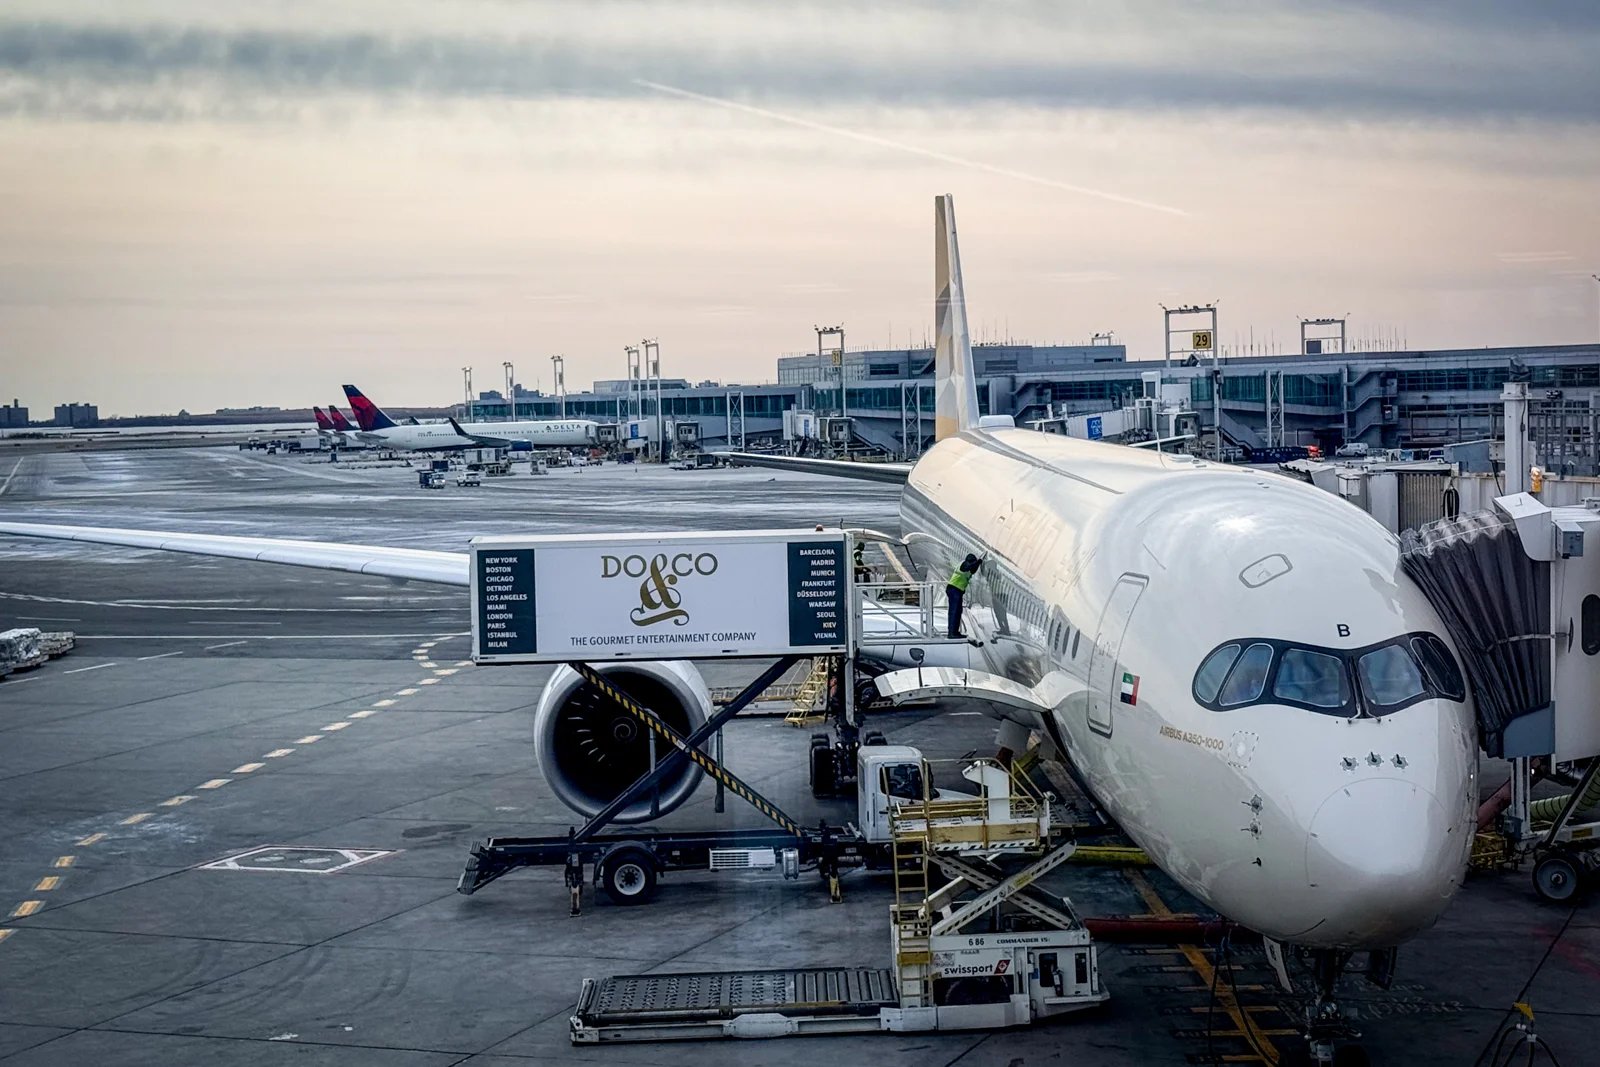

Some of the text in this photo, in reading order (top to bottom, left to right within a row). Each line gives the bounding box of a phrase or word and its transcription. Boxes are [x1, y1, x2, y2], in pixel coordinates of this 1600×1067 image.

[1195, 334, 1208, 347] 29
[601, 553, 718, 627] DO&CO
[796, 590, 836, 598] DÜSSELDORF
[499, 593, 528, 601] ANGELES
[487, 622, 506, 630] PARIS
[1336, 623, 1351, 638] B
[487, 631, 518, 639] ISTANBUL
[571, 631, 757, 646] THE GOURMET ENTERTAINMENT COMPANY
[1159, 725, 1224, 751] AIRBUS A350-1000
[996, 937, 1039, 945] COMMANDER
[944, 963, 994, 976] swissport
